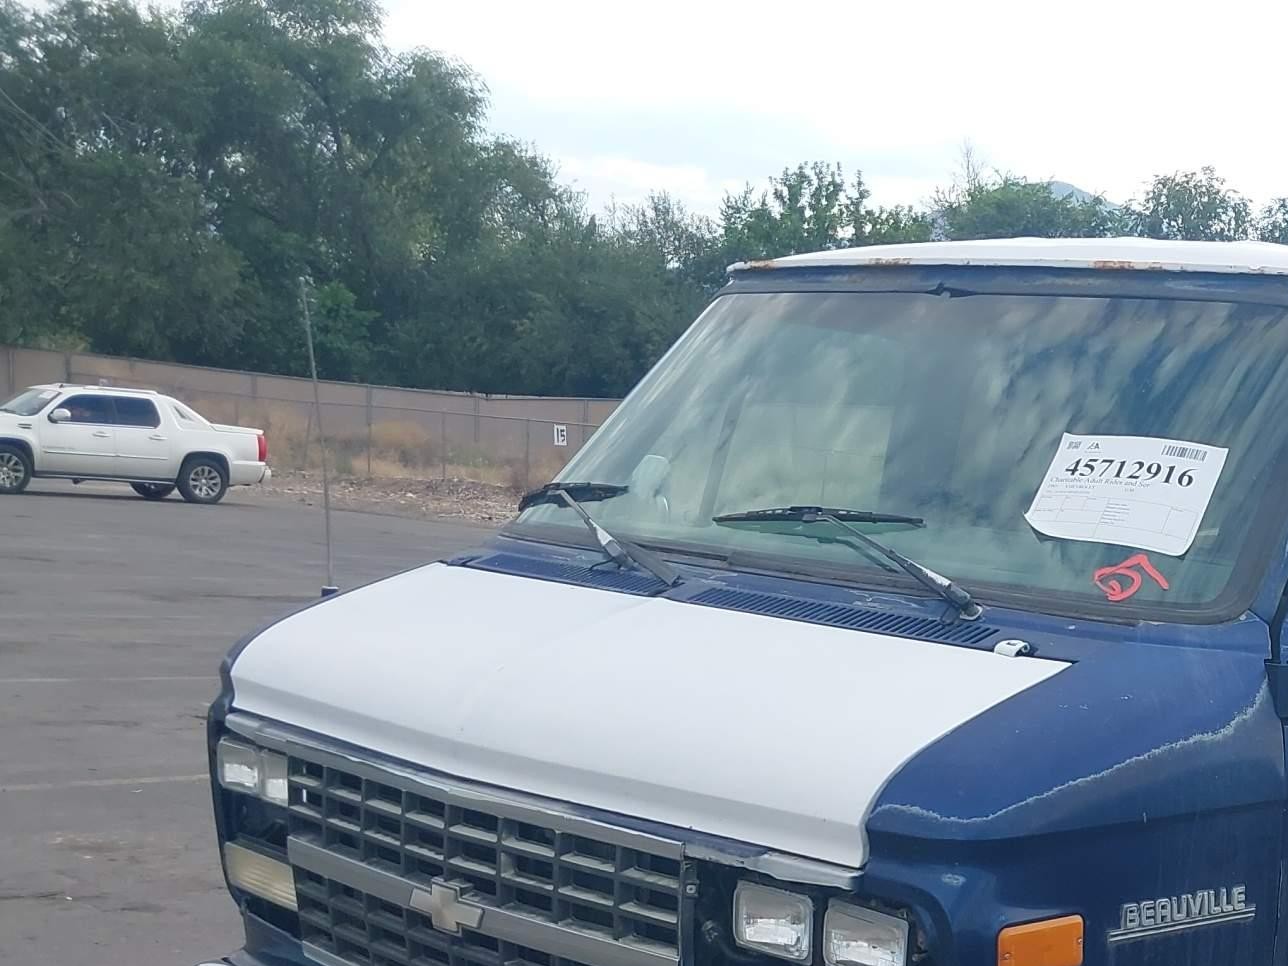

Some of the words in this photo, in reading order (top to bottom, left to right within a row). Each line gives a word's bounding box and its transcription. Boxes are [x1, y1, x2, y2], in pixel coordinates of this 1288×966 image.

[556, 427, 566, 443] 15
[1065, 457, 1200, 488] 45712916
[1120, 884, 1246, 929] BEAUVILLE
